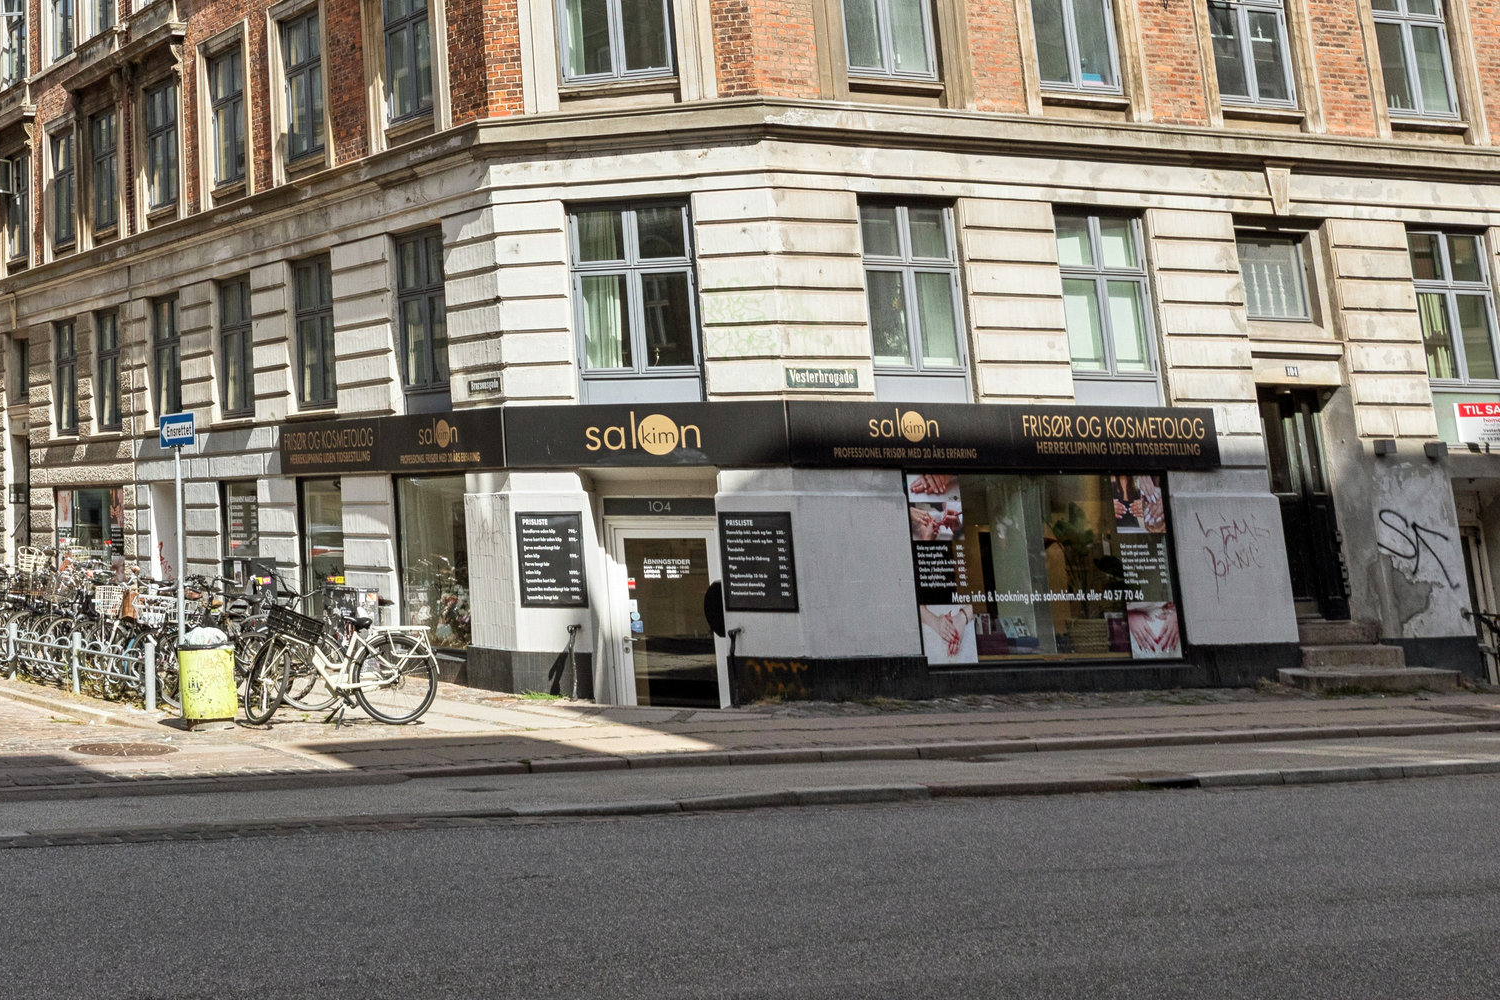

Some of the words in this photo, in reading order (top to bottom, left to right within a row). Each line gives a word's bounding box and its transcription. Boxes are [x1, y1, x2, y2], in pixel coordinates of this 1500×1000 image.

[789, 369, 855, 386] Vesterbrogade
[1462, 405, 1484, 415] TIL
[166, 424, 192, 437] Ensrettet
[585, 411, 701, 455] salon
[903, 422, 924, 434] kim
[1022, 415, 1072, 438] FRISØR
[1076, 415, 1101, 438] OG
[1105, 416, 1205, 439] KOSMETOLOG
[284, 431, 306, 450] FRISØR
[308, 431, 320, 449] OG
[322, 427, 373, 449] KOSMETOLOG
[641, 425, 675, 444] kim
[833, 447, 882, 458] PROFESSIONEL
[883, 448, 907, 458] FRISØR
[908, 448, 921, 458] MED
[923, 448, 932, 458] 20
[932, 445, 945, 458] ÅRS
[946, 448, 977, 459] ERFARING
[1036, 441, 1107, 455] HERREKLIPNING
[1109, 442, 1133, 455] UDEN
[1135, 442, 1200, 456] TIDSBESTILLING
[323, 452, 336, 463] UDEN
[648, 501, 671, 512] 104
[643, 557, 690, 565] ÅBNINGSTIDER
[952, 591, 970, 603] Mere
[971, 590, 986, 602] info
[987, 591, 993, 602] &
[994, 590, 1028, 604] bookning
[1030, 590, 1041, 604] på:
[1043, 589, 1085, 601] salonkim.dk
[1087, 589, 1102, 600] eller
[1103, 589, 1113, 600] 40
[1114, 589, 1122, 600] 57
[1124, 589, 1133, 600] 70
[1134, 589, 1144, 600] 46
